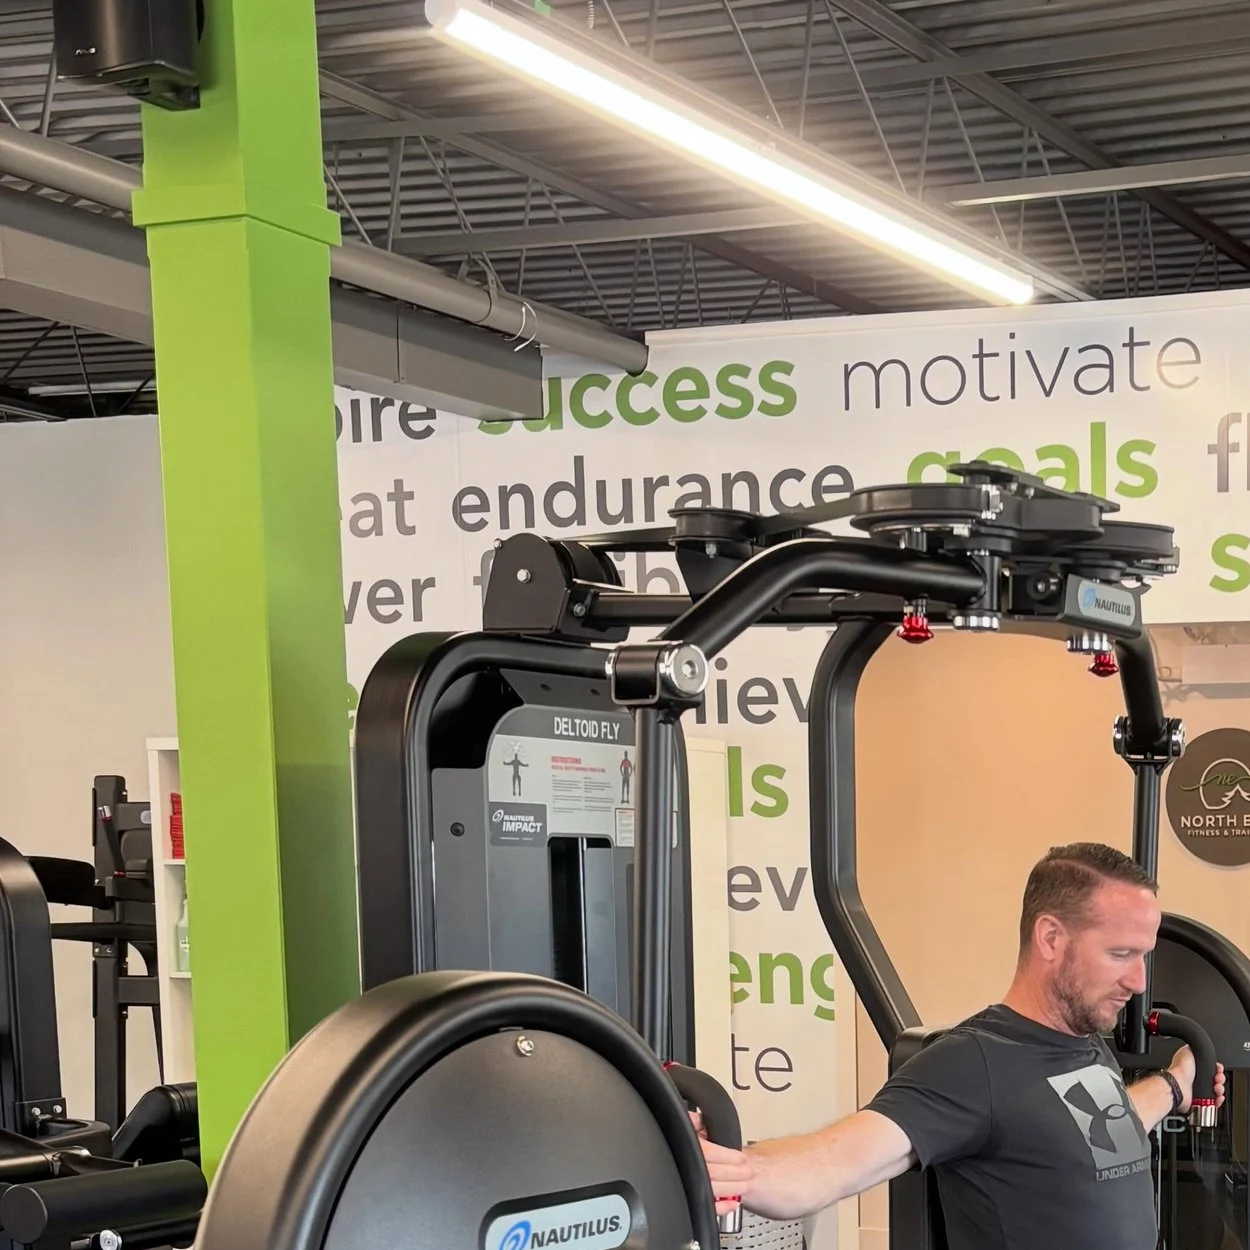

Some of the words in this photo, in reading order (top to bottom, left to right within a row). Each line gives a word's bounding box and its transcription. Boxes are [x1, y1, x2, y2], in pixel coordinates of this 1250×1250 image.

[477, 358, 798, 435] uccess
[842, 326, 1202, 411] motivate
[451, 454, 855, 533] endurance
[1094, 596, 1132, 617] NAUTILUS
[553, 717, 599, 739] DELTOID
[601, 721, 620, 740] FLY
[502, 820, 543, 833] IMPACT
[1180, 814, 1237, 829] NORTH
[1187, 828, 1220, 837] FITNESS
[1096, 1164, 1130, 1182] UNDER
[530, 1215, 623, 1250] NAUTILUS
